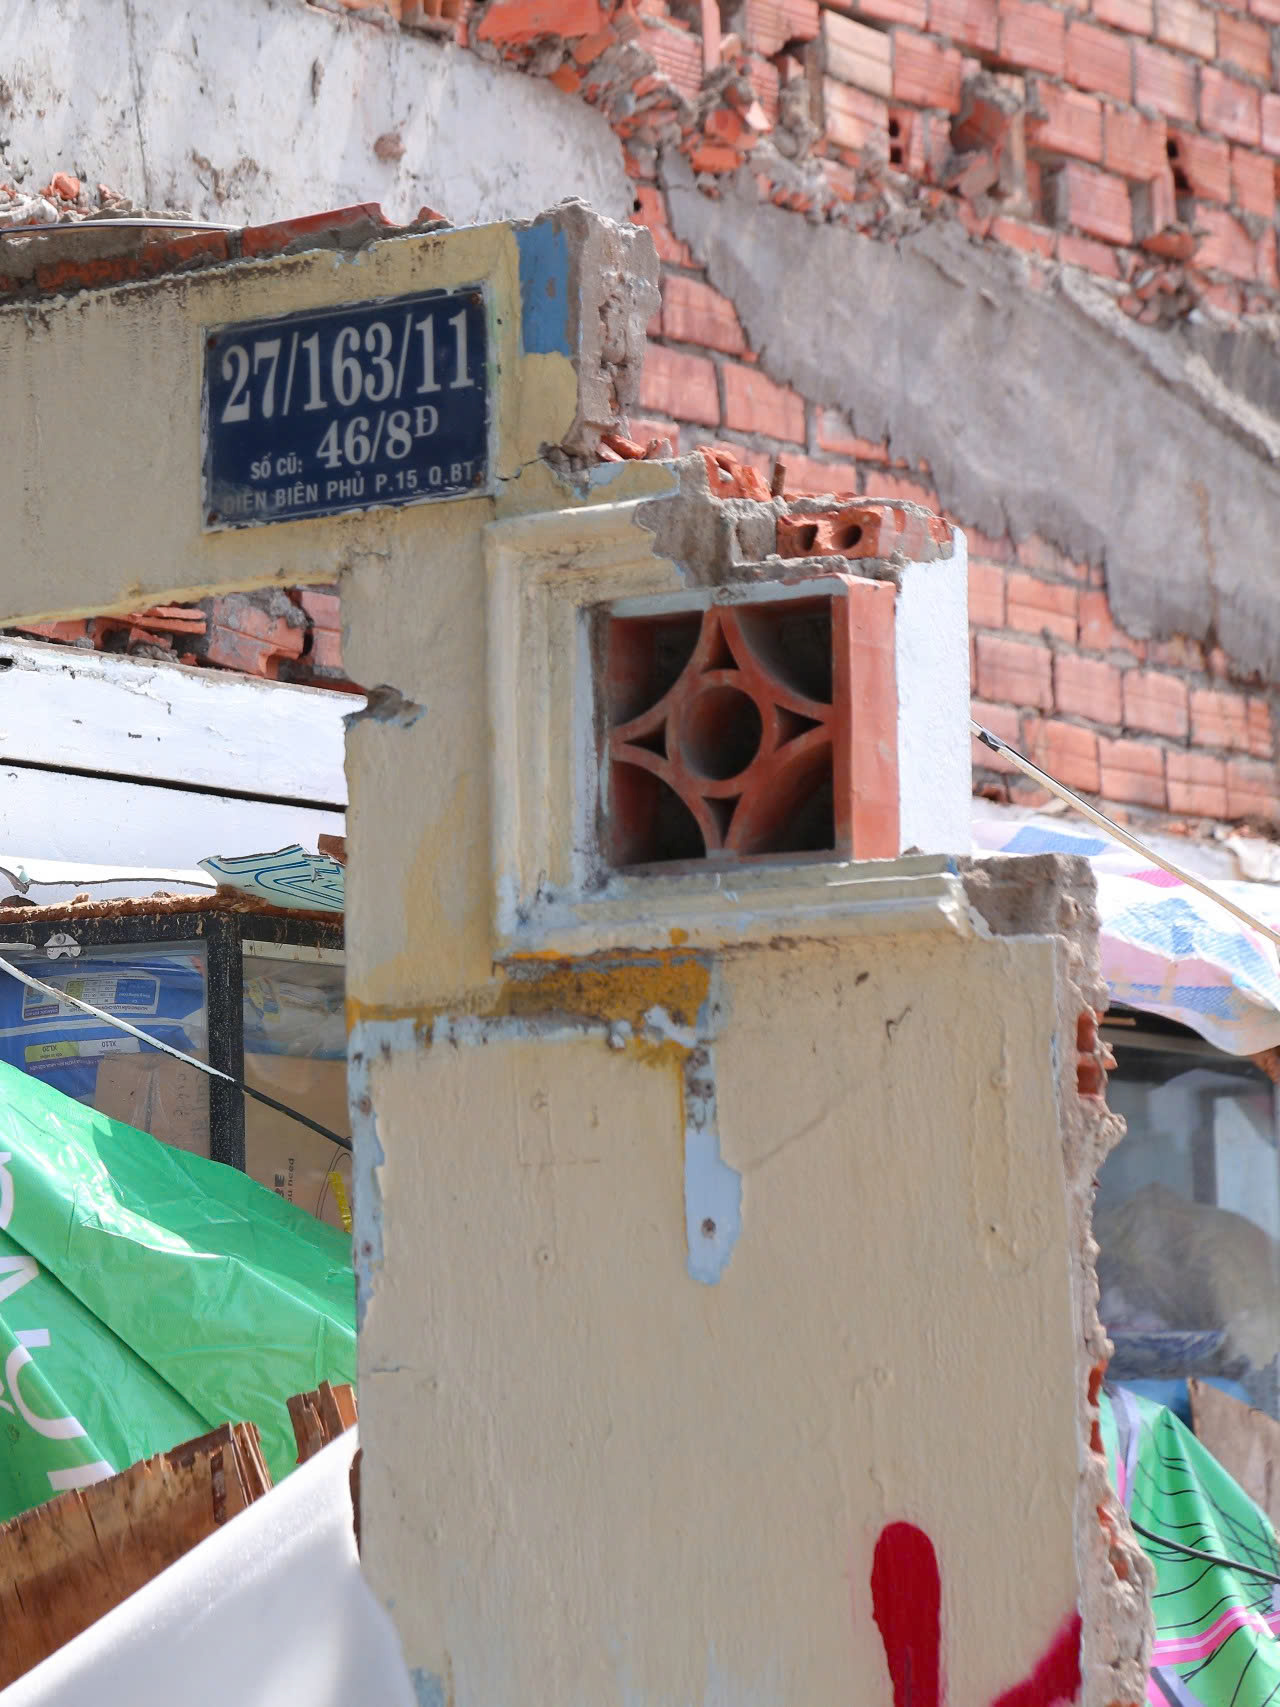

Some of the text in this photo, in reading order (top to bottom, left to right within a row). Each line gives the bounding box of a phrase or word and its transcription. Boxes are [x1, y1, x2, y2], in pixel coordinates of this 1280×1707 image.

[220, 309, 475, 424] 27/163/11
[250, 452, 272, 480] SỐ
[276, 452, 303, 476] CŨ:
[275, 481, 319, 507] BIÊN
[326, 470, 365, 499] PHỦ
[375, 469, 418, 494] P.15
[429, 461, 475, 486] Q.BT
[101, 1040, 117, 1048] XL10
[287, 1158, 295, 1187] need
